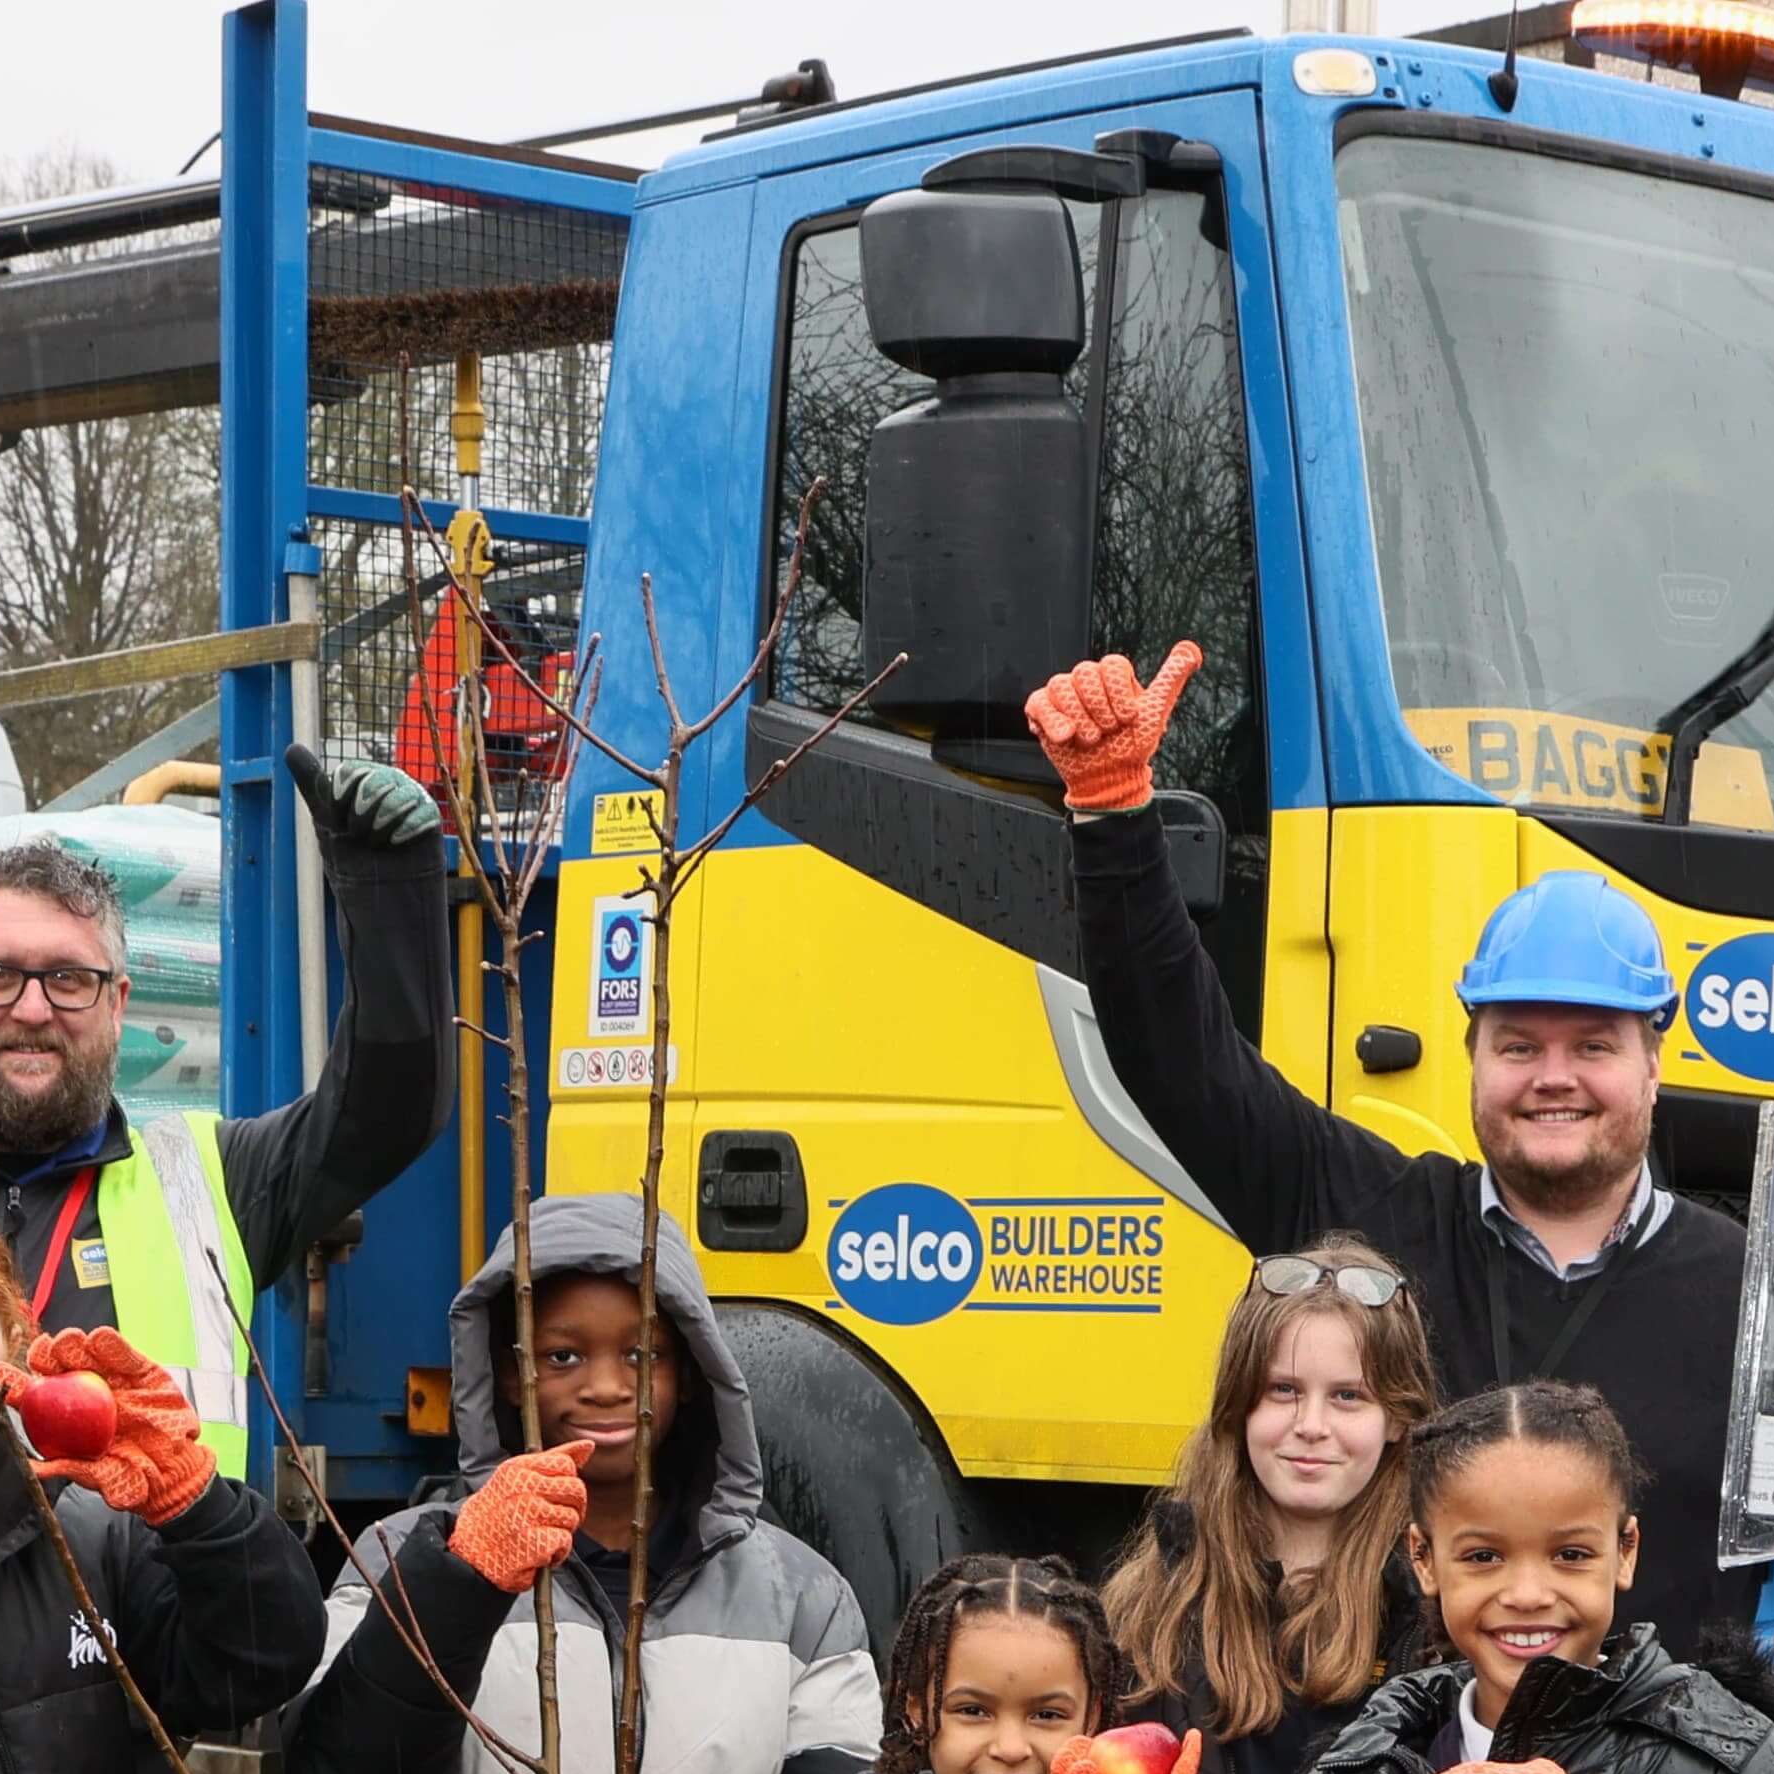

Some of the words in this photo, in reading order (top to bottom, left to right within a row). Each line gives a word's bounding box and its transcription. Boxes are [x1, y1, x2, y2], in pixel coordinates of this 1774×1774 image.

[1427, 743, 1454, 755] VECO
[1468, 720, 1668, 806] BAGG
[601, 979, 638, 1001] FORS
[836, 1213, 973, 1283] selco
[990, 1214, 1164, 1258] BUILDERS
[990, 1263, 1163, 1295] WAREHOUSE
